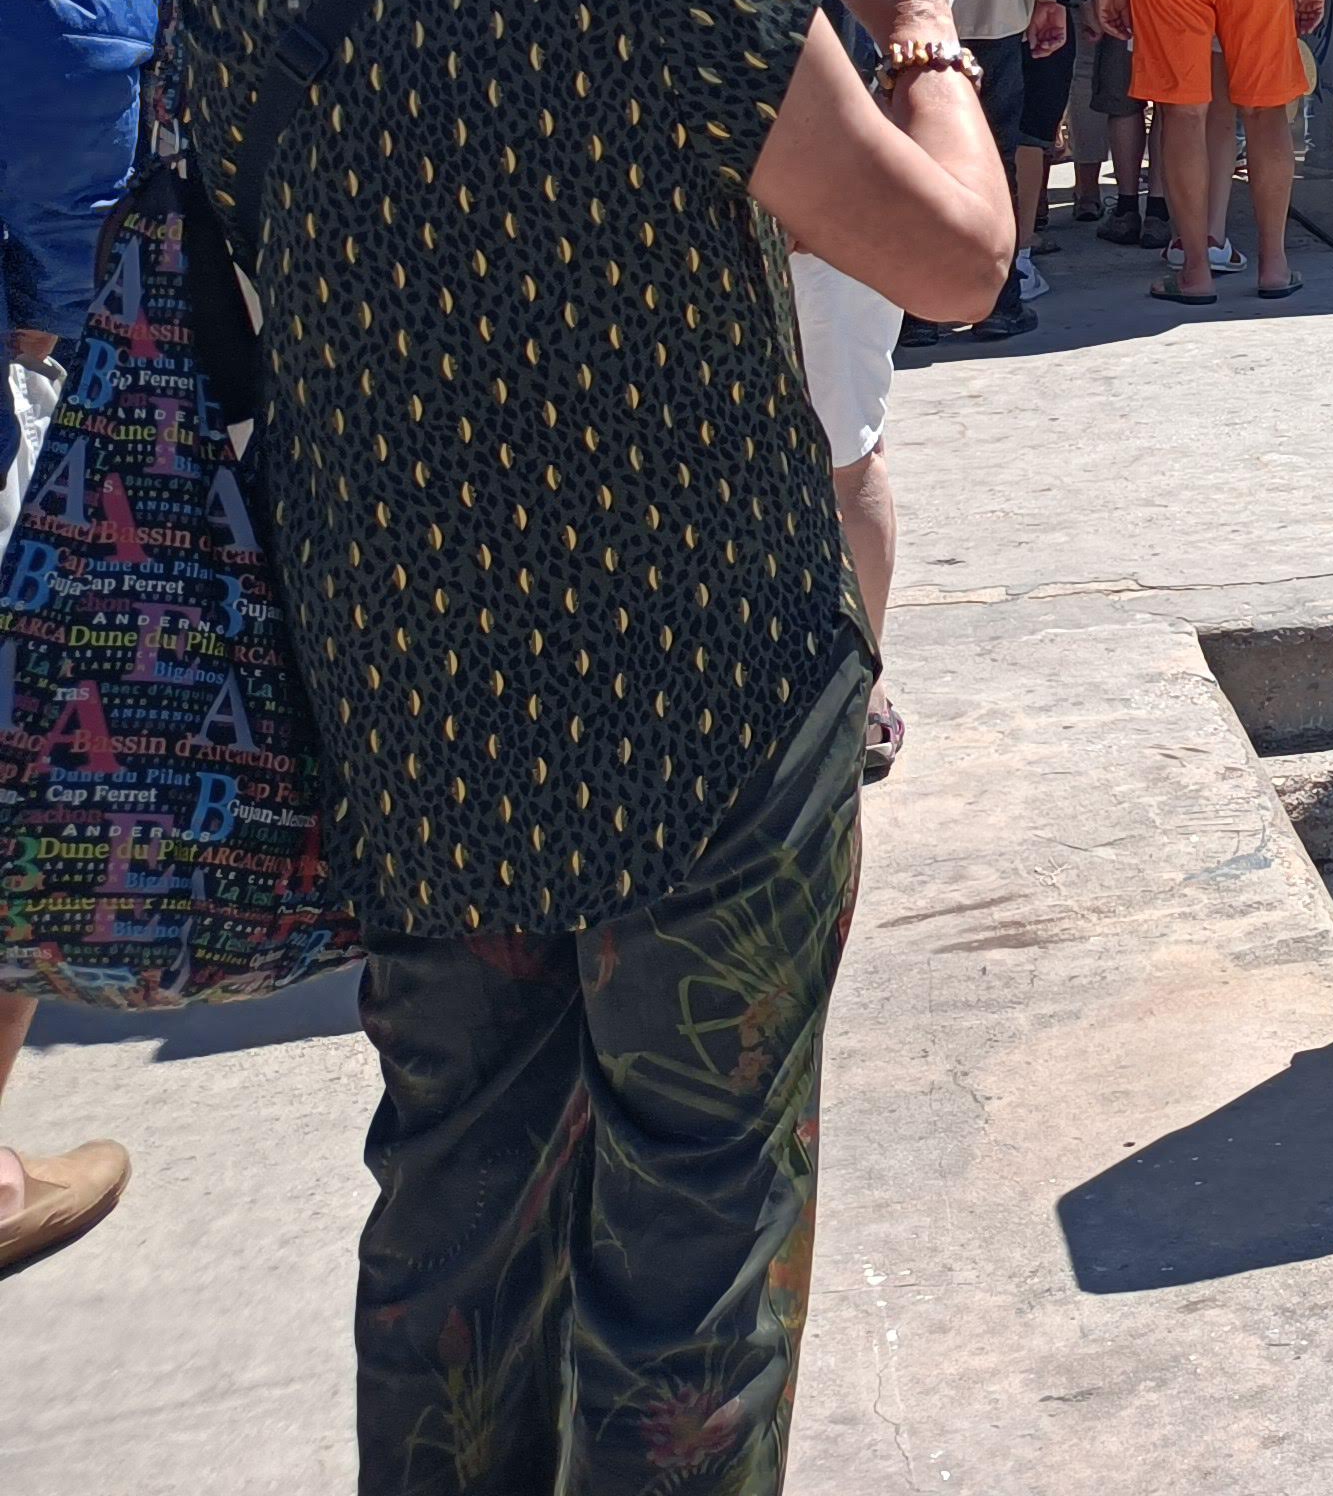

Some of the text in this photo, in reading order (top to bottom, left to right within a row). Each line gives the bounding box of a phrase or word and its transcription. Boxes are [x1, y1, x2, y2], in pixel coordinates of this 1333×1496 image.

[122, 574, 185, 595] Ferret
[68, 624, 138, 647] Dune
[144, 625, 177, 648] du
[153, 659, 226, 686] Biganos
[70, 728, 167, 756] Bassin
[46, 784, 158, 806] Cap Ferret
[37, 836, 110, 860] Dune
[116, 836, 150, 861] du
